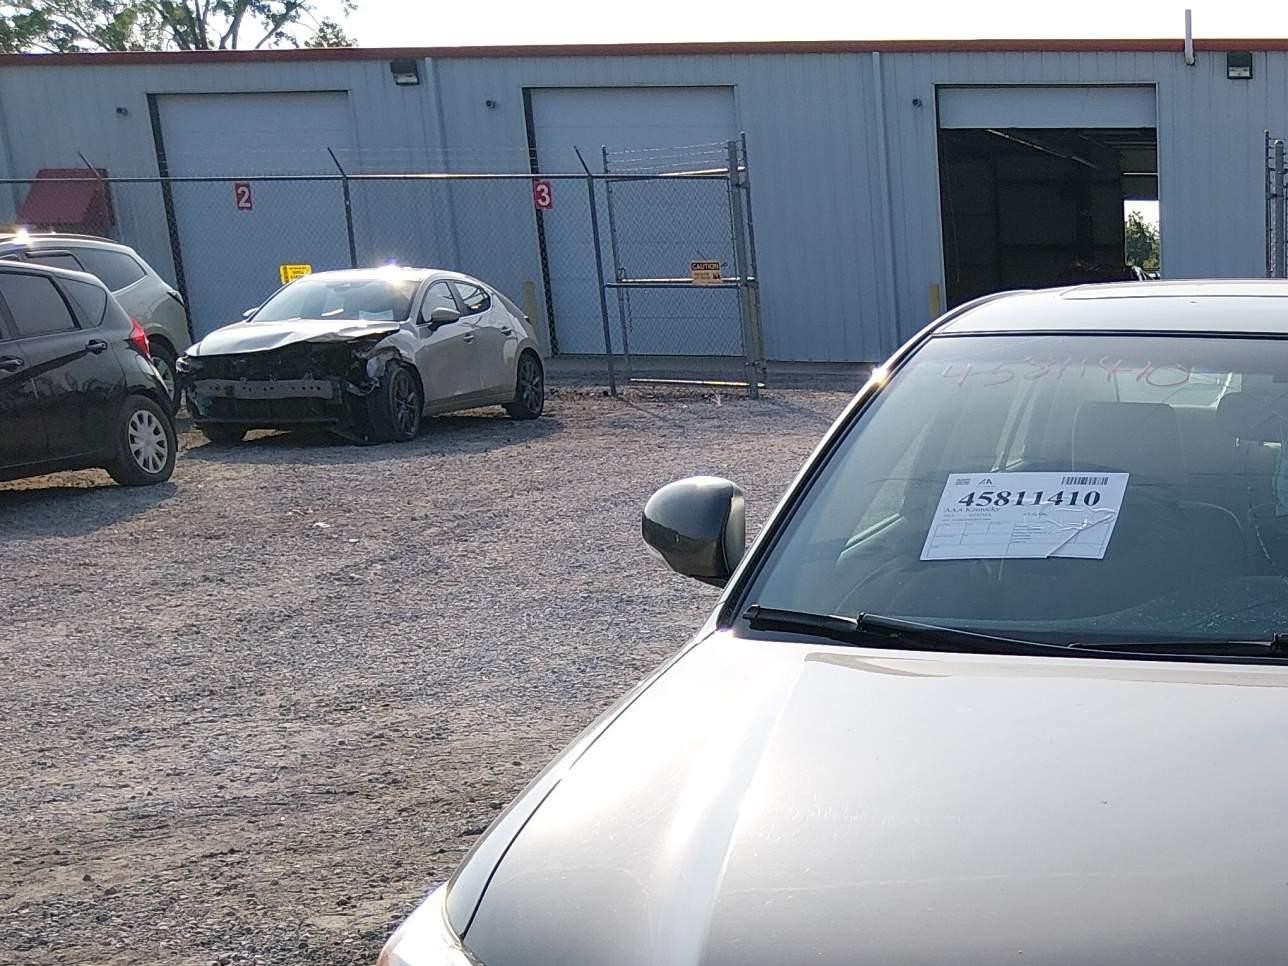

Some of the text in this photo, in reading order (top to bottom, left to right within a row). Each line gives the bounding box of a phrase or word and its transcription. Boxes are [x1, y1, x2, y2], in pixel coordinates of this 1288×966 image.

[237, 186, 251, 208] 2
[536, 184, 550, 206] 3
[942, 356, 1191, 388] 45811410
[957, 490, 1101, 507] 45811410
